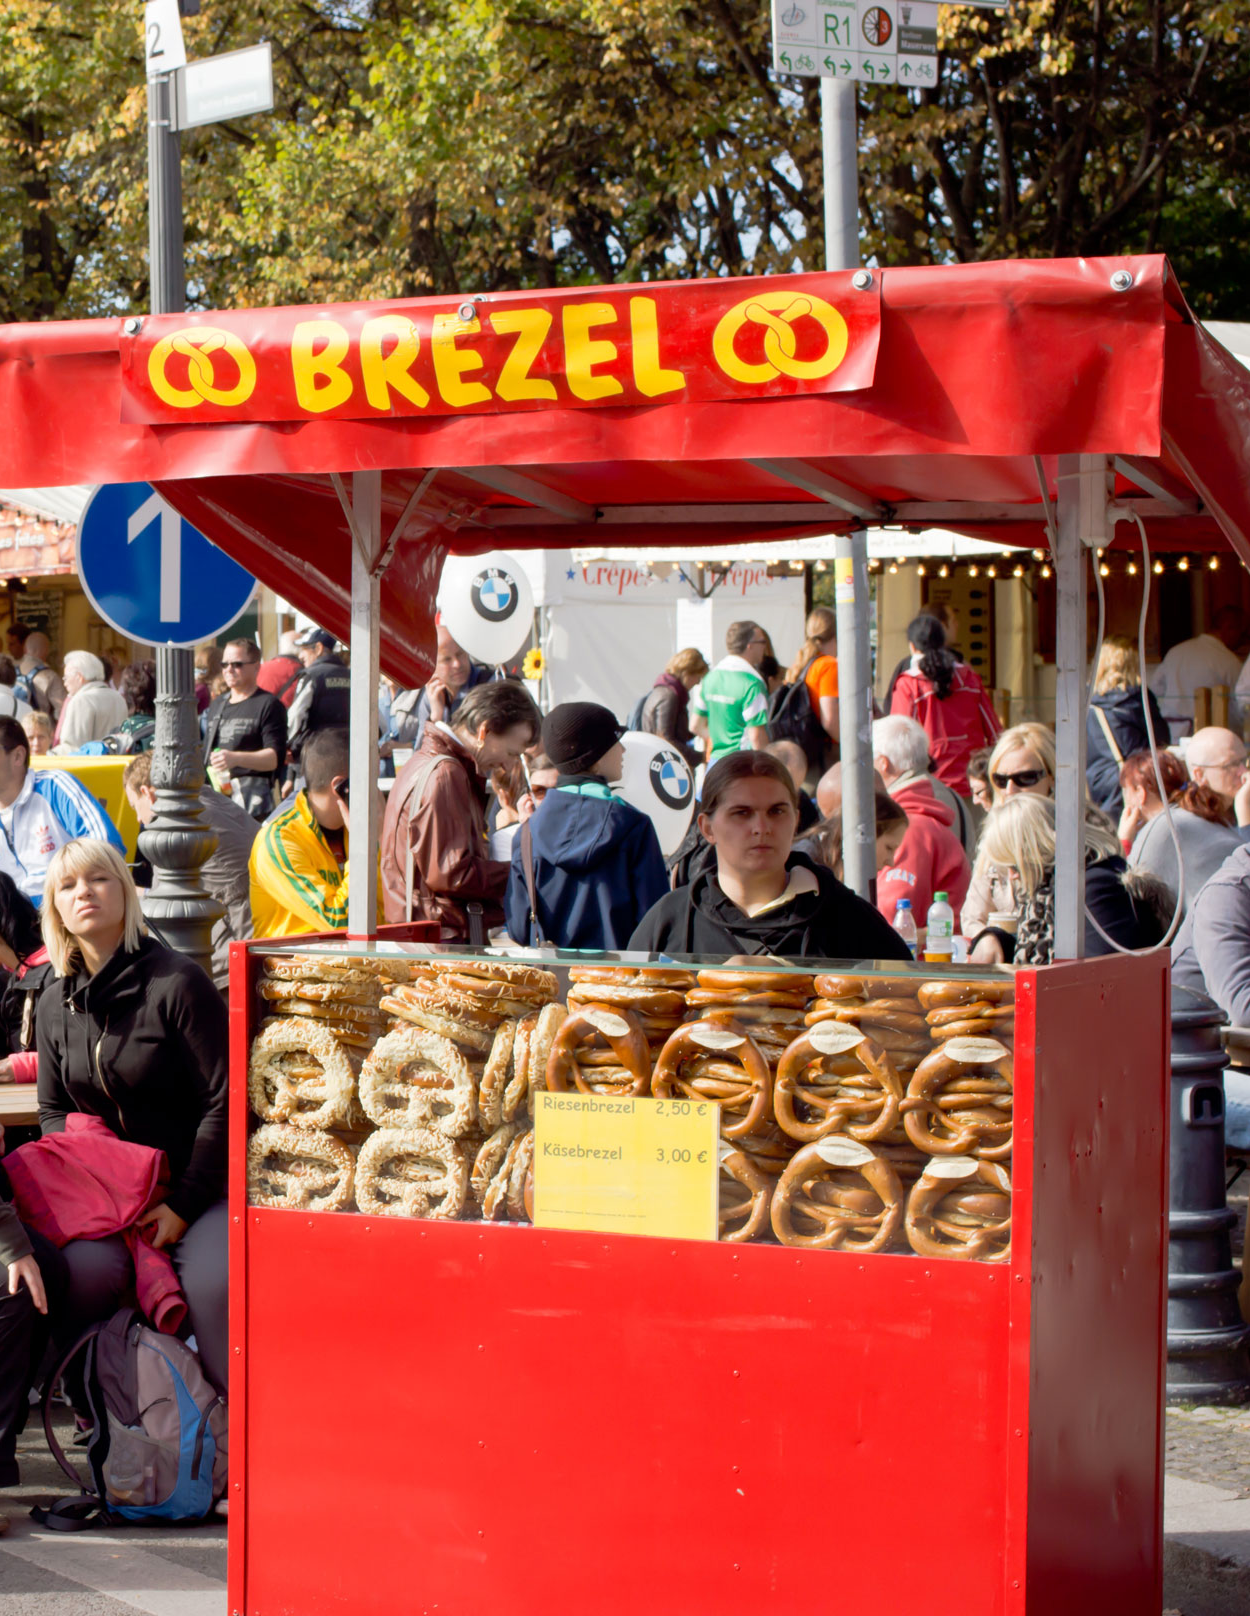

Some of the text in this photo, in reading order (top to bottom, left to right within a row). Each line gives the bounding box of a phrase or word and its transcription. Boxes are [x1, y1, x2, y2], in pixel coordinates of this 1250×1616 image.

[824, 13, 850, 45] R1
[881, 21, 889, 33] 3
[147, 22, 165, 58] 2
[291, 296, 686, 414] BREZEL
[472, 567, 515, 588] BMW
[543, 1096, 707, 1117] Riesenbrezel 2,50 €
[543, 1142, 707, 1165] Käsebrezel 3,00 €
